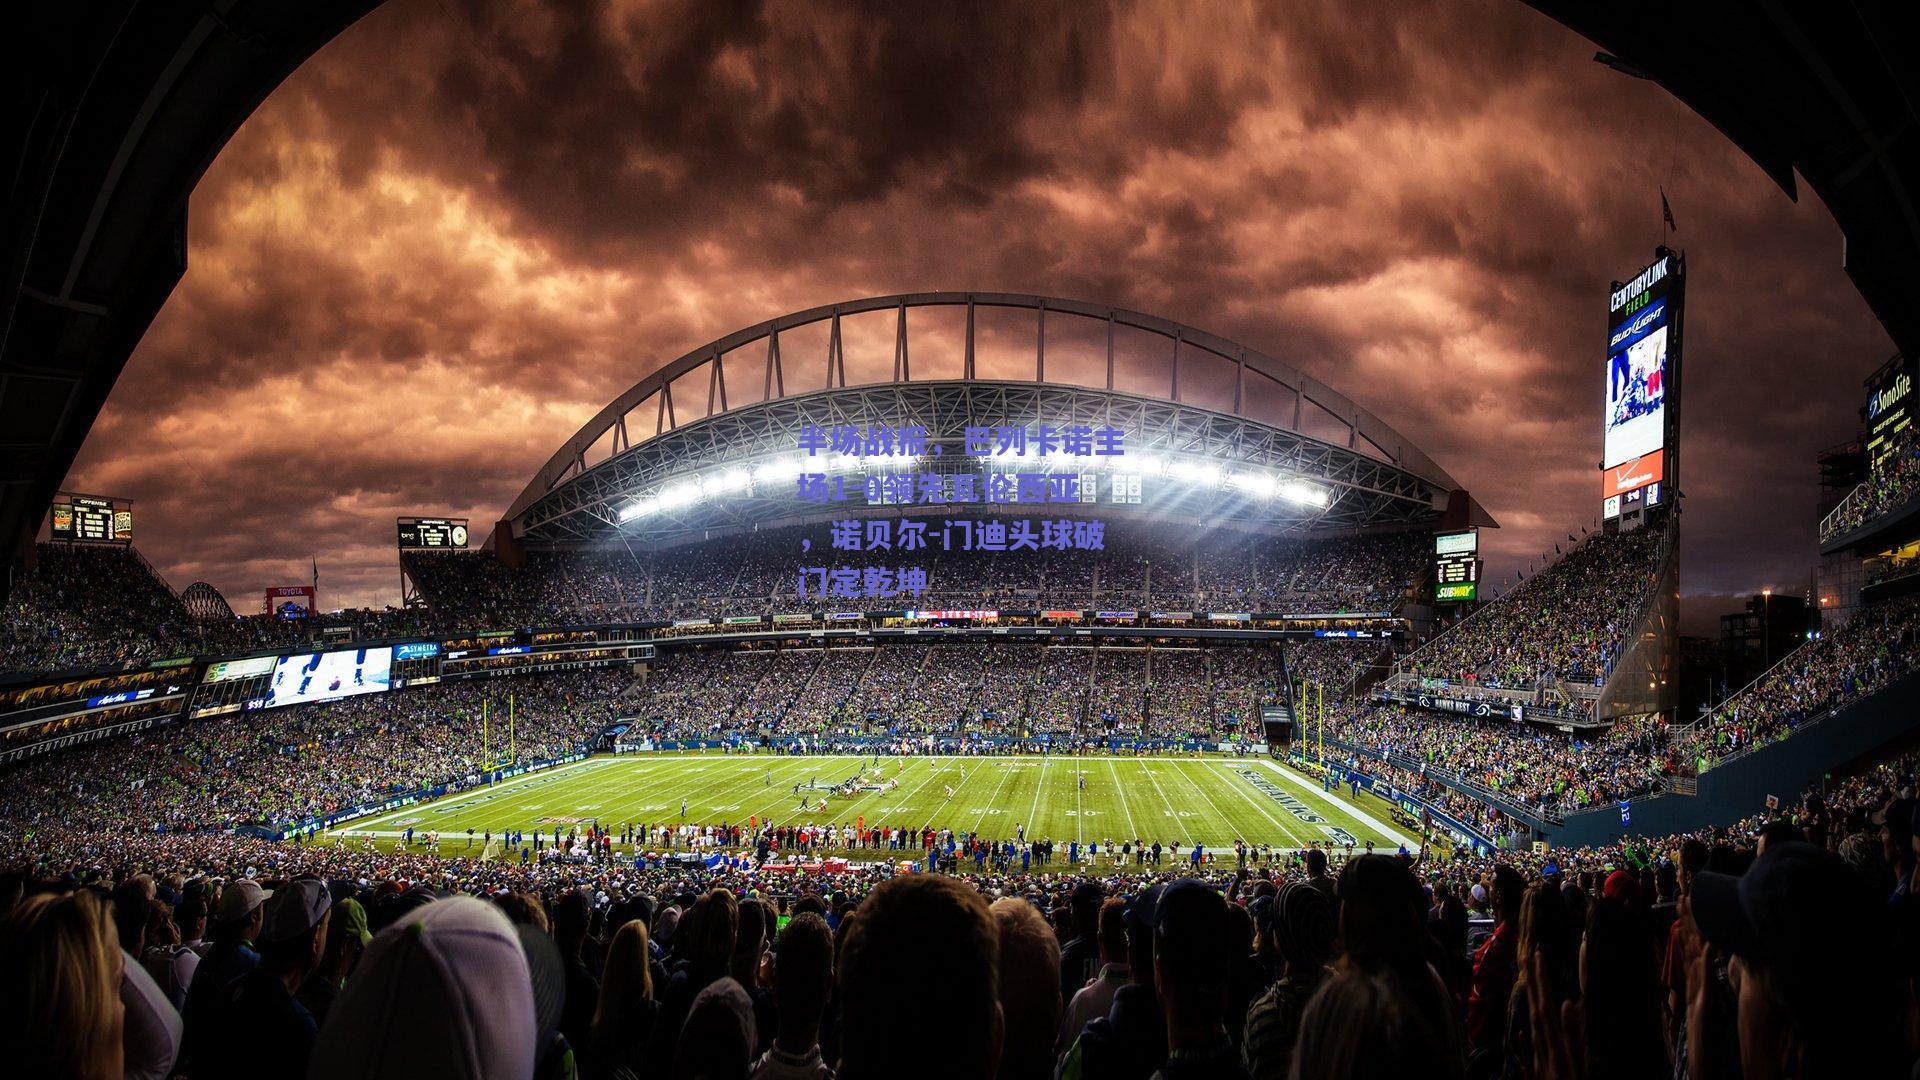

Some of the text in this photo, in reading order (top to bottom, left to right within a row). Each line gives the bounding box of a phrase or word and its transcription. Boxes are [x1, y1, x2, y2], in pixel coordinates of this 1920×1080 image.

[1611, 256, 1669, 312] CENTURYLINK
[1625, 290, 1650, 316] FIELD
[1610, 305, 1665, 347] BUD LIGHT
[1878, 373, 1911, 414] SonoSite
[1873, 407, 1905, 434] DEFENSE
[80, 499, 107, 507] OFFENSE
[278, 588, 303, 596] TOYOTA
[1437, 585, 1474, 598] SUBWAY
[409, 644, 438, 652] SYMETRA
[490, 660, 609, 677] HOME OF THE 12TH MAN
[10, 720, 153, 762] TO CENTURYLINK FIELD
[1620, 805, 1630, 822] 12
